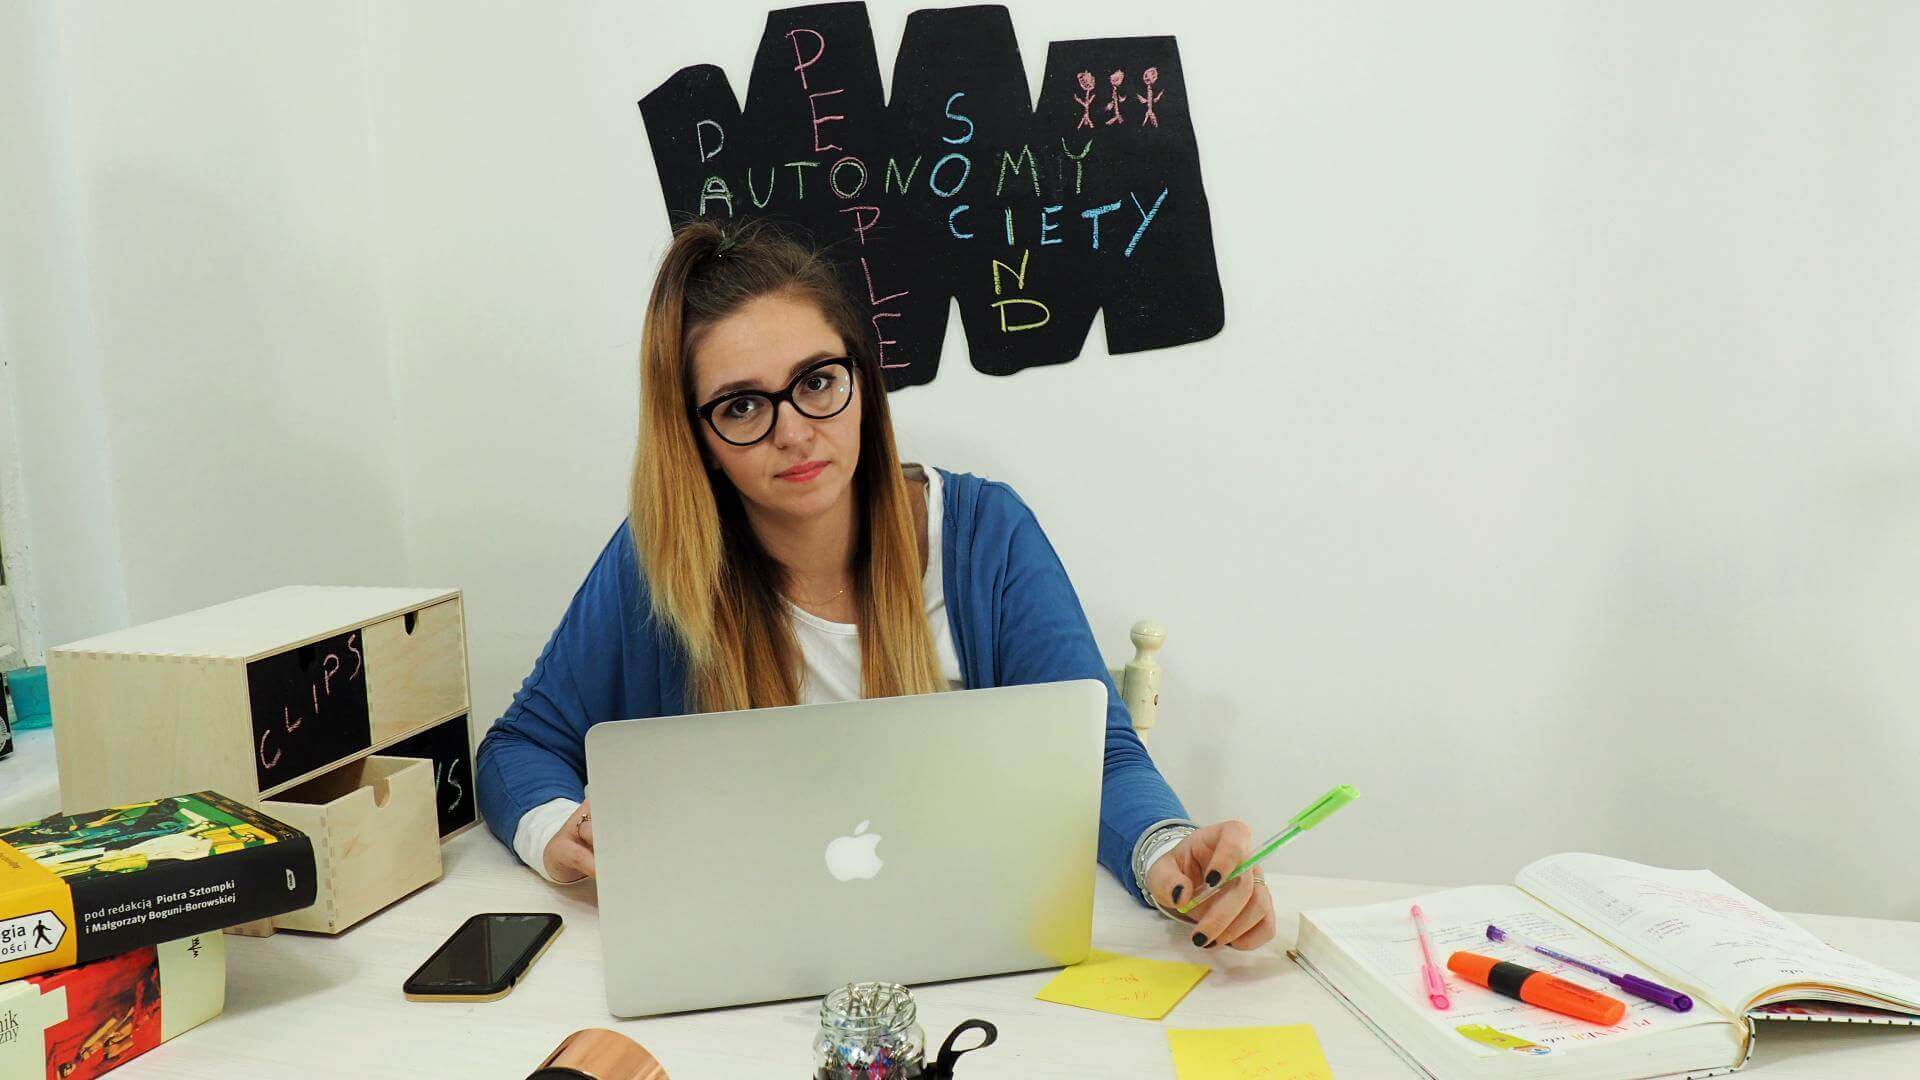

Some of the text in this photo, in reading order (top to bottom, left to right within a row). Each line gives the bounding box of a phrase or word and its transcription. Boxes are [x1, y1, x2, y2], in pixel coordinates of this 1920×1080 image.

[697, 120, 733, 238] DA
[700, 138, 1093, 217] AUTONOMY
[786, 28, 910, 370] PEOPLE
[260, 633, 362, 769] CLIPS
[84, 880, 235, 923] pod redakcją Piotra Sztompki
[149, 893, 236, 920] Boguni-Borowskiej
